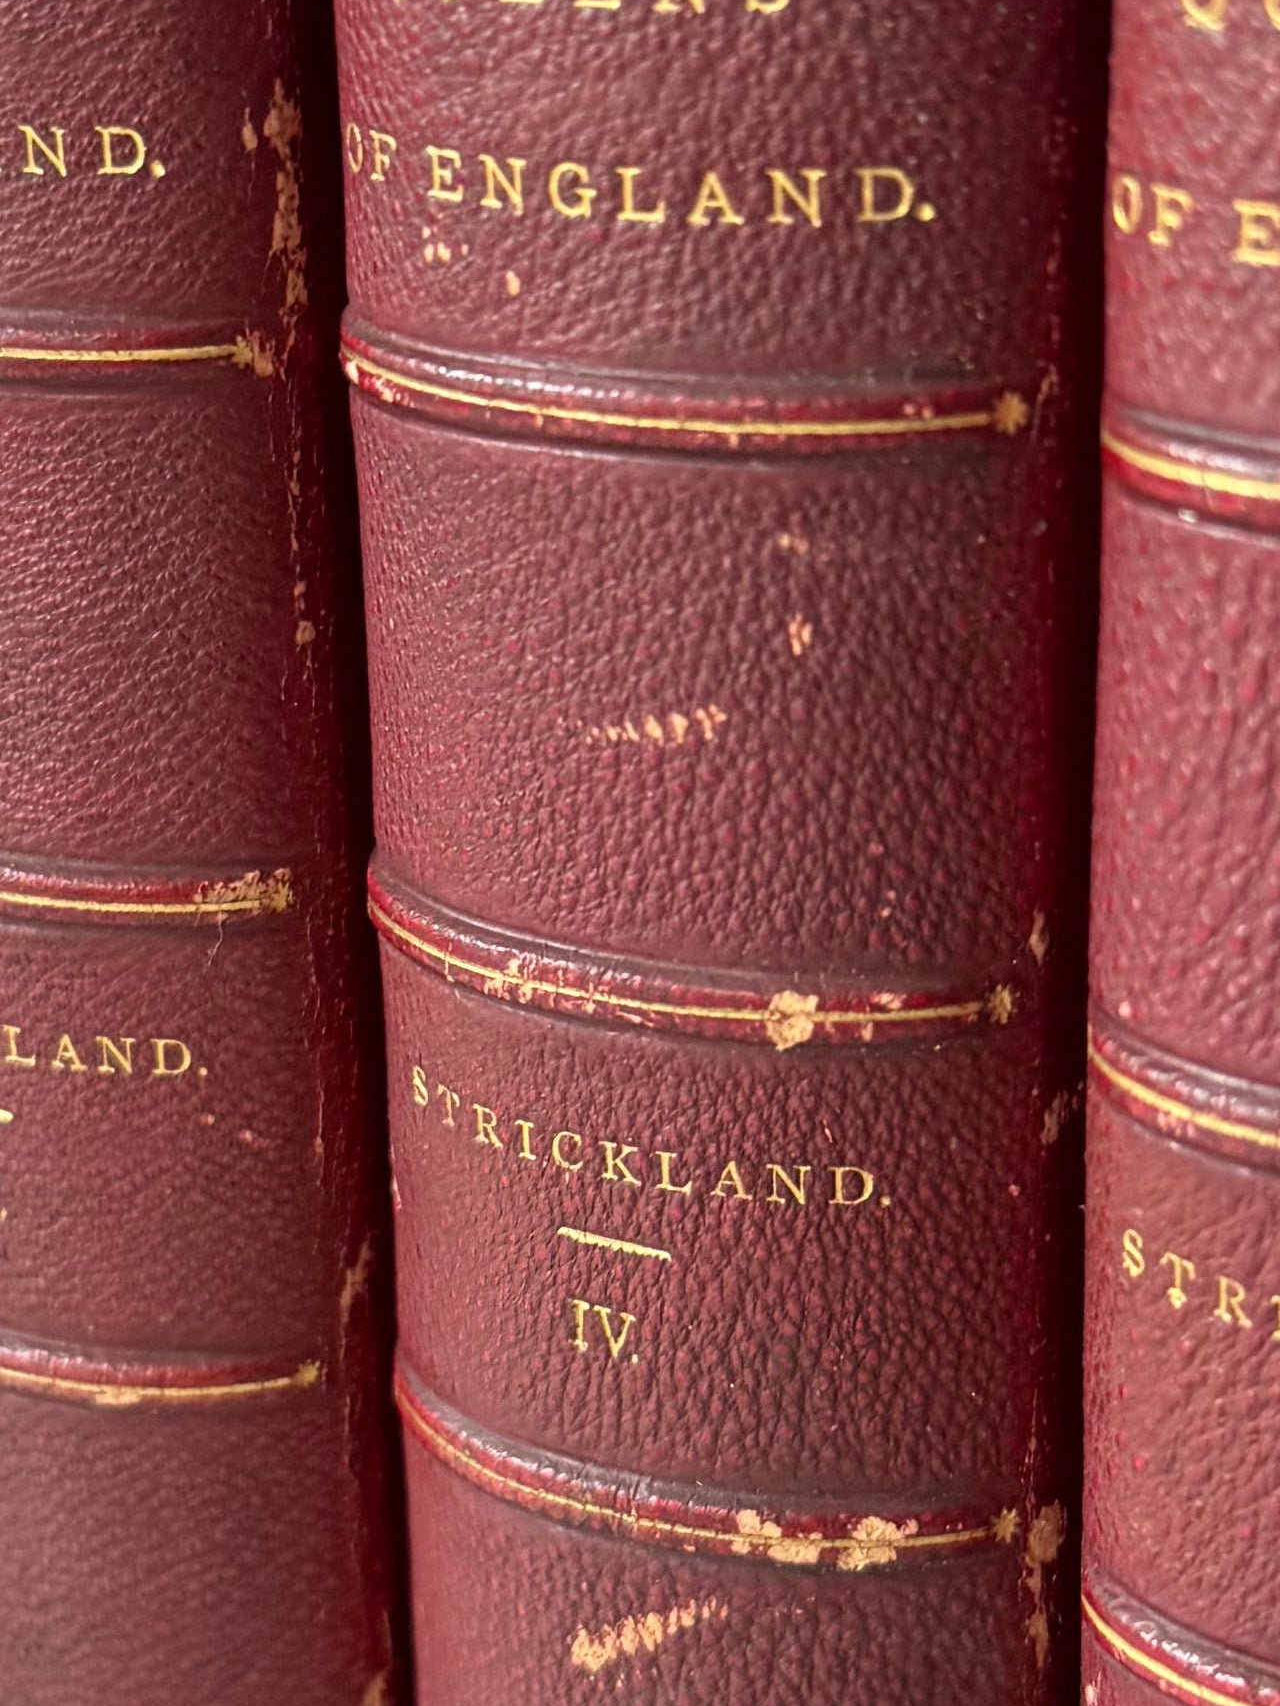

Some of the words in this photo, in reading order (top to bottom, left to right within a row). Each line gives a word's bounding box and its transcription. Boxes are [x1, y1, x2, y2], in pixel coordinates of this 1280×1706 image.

[345, 121, 397, 183] OF
[425, 144, 935, 228] ENGLAND.
[1112, 175, 1194, 248] OF
[412, 1064, 892, 1207] STRICKLAND.
[571, 1299, 640, 1364] IV.
